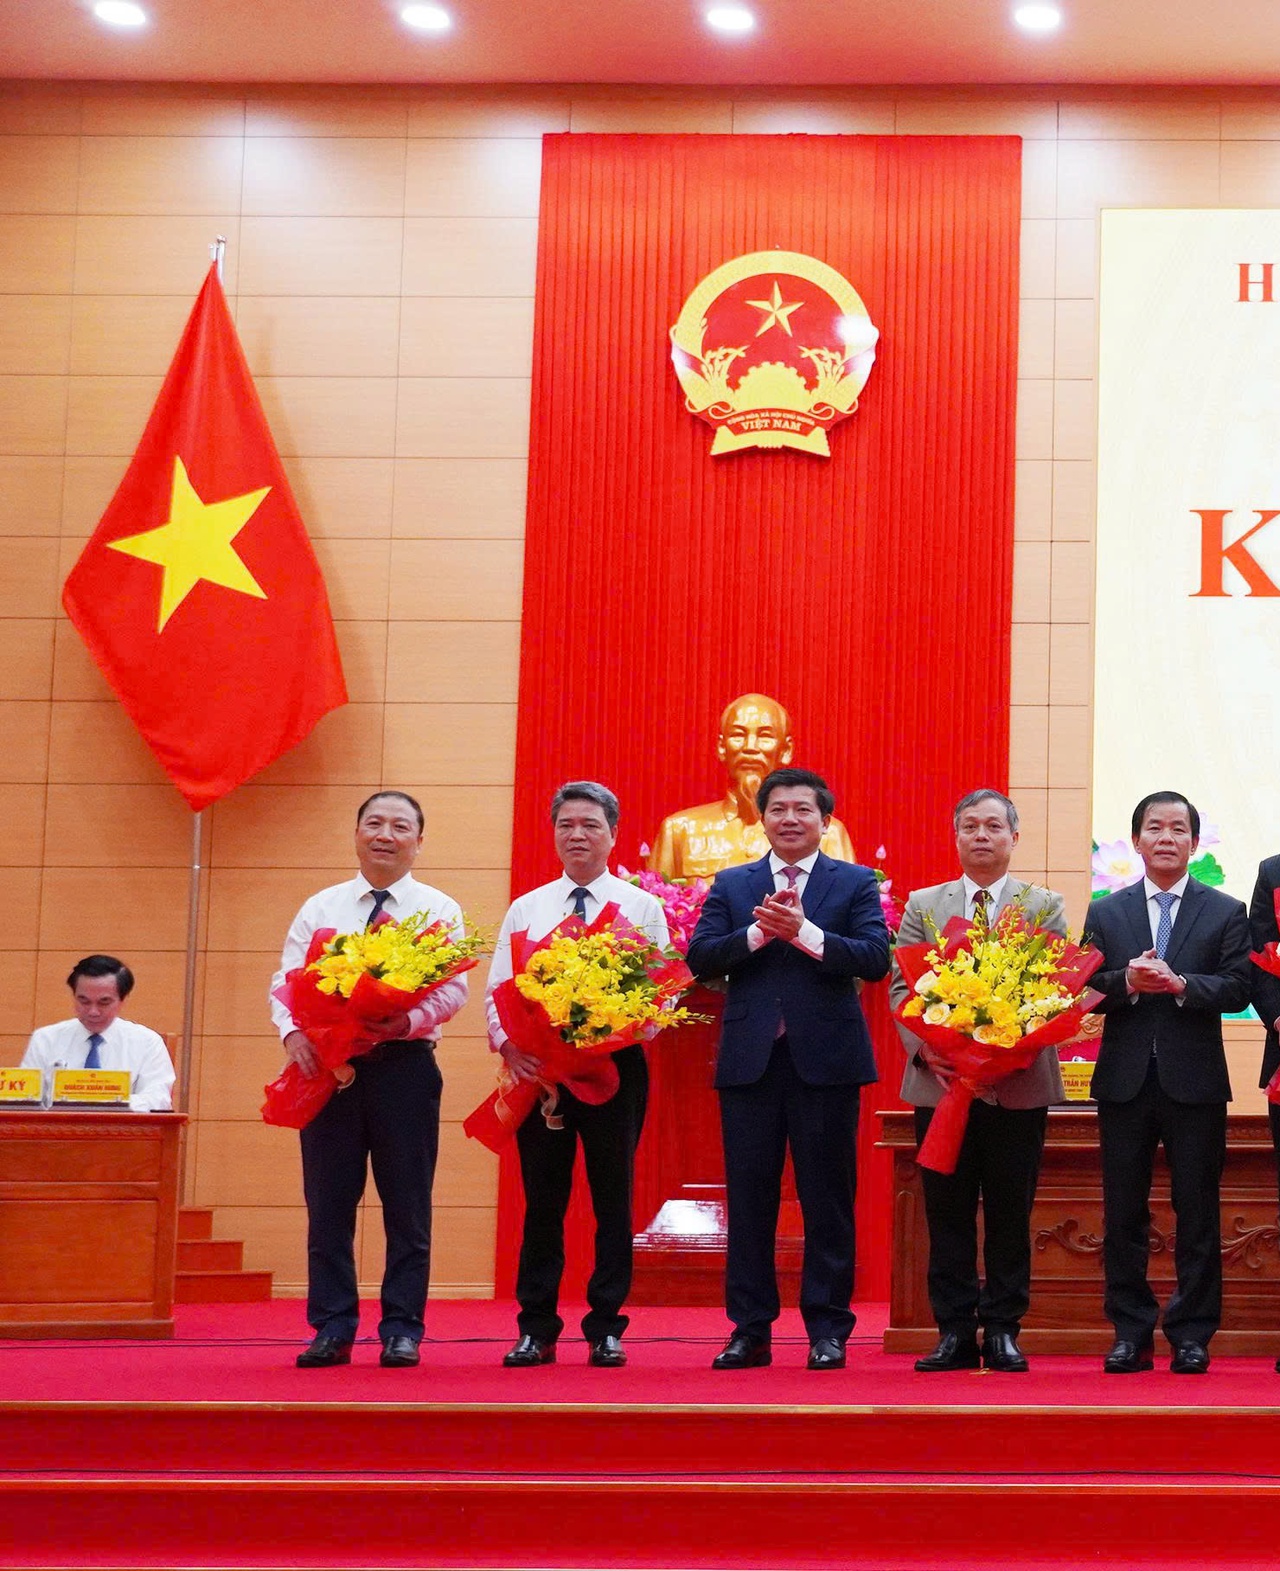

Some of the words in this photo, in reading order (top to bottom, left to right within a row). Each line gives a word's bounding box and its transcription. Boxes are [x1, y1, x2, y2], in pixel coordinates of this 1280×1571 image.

[741, 419, 770, 430] VIỆT
[773, 419, 802, 431] NAM
[9, 1080, 26, 1091] KÝ
